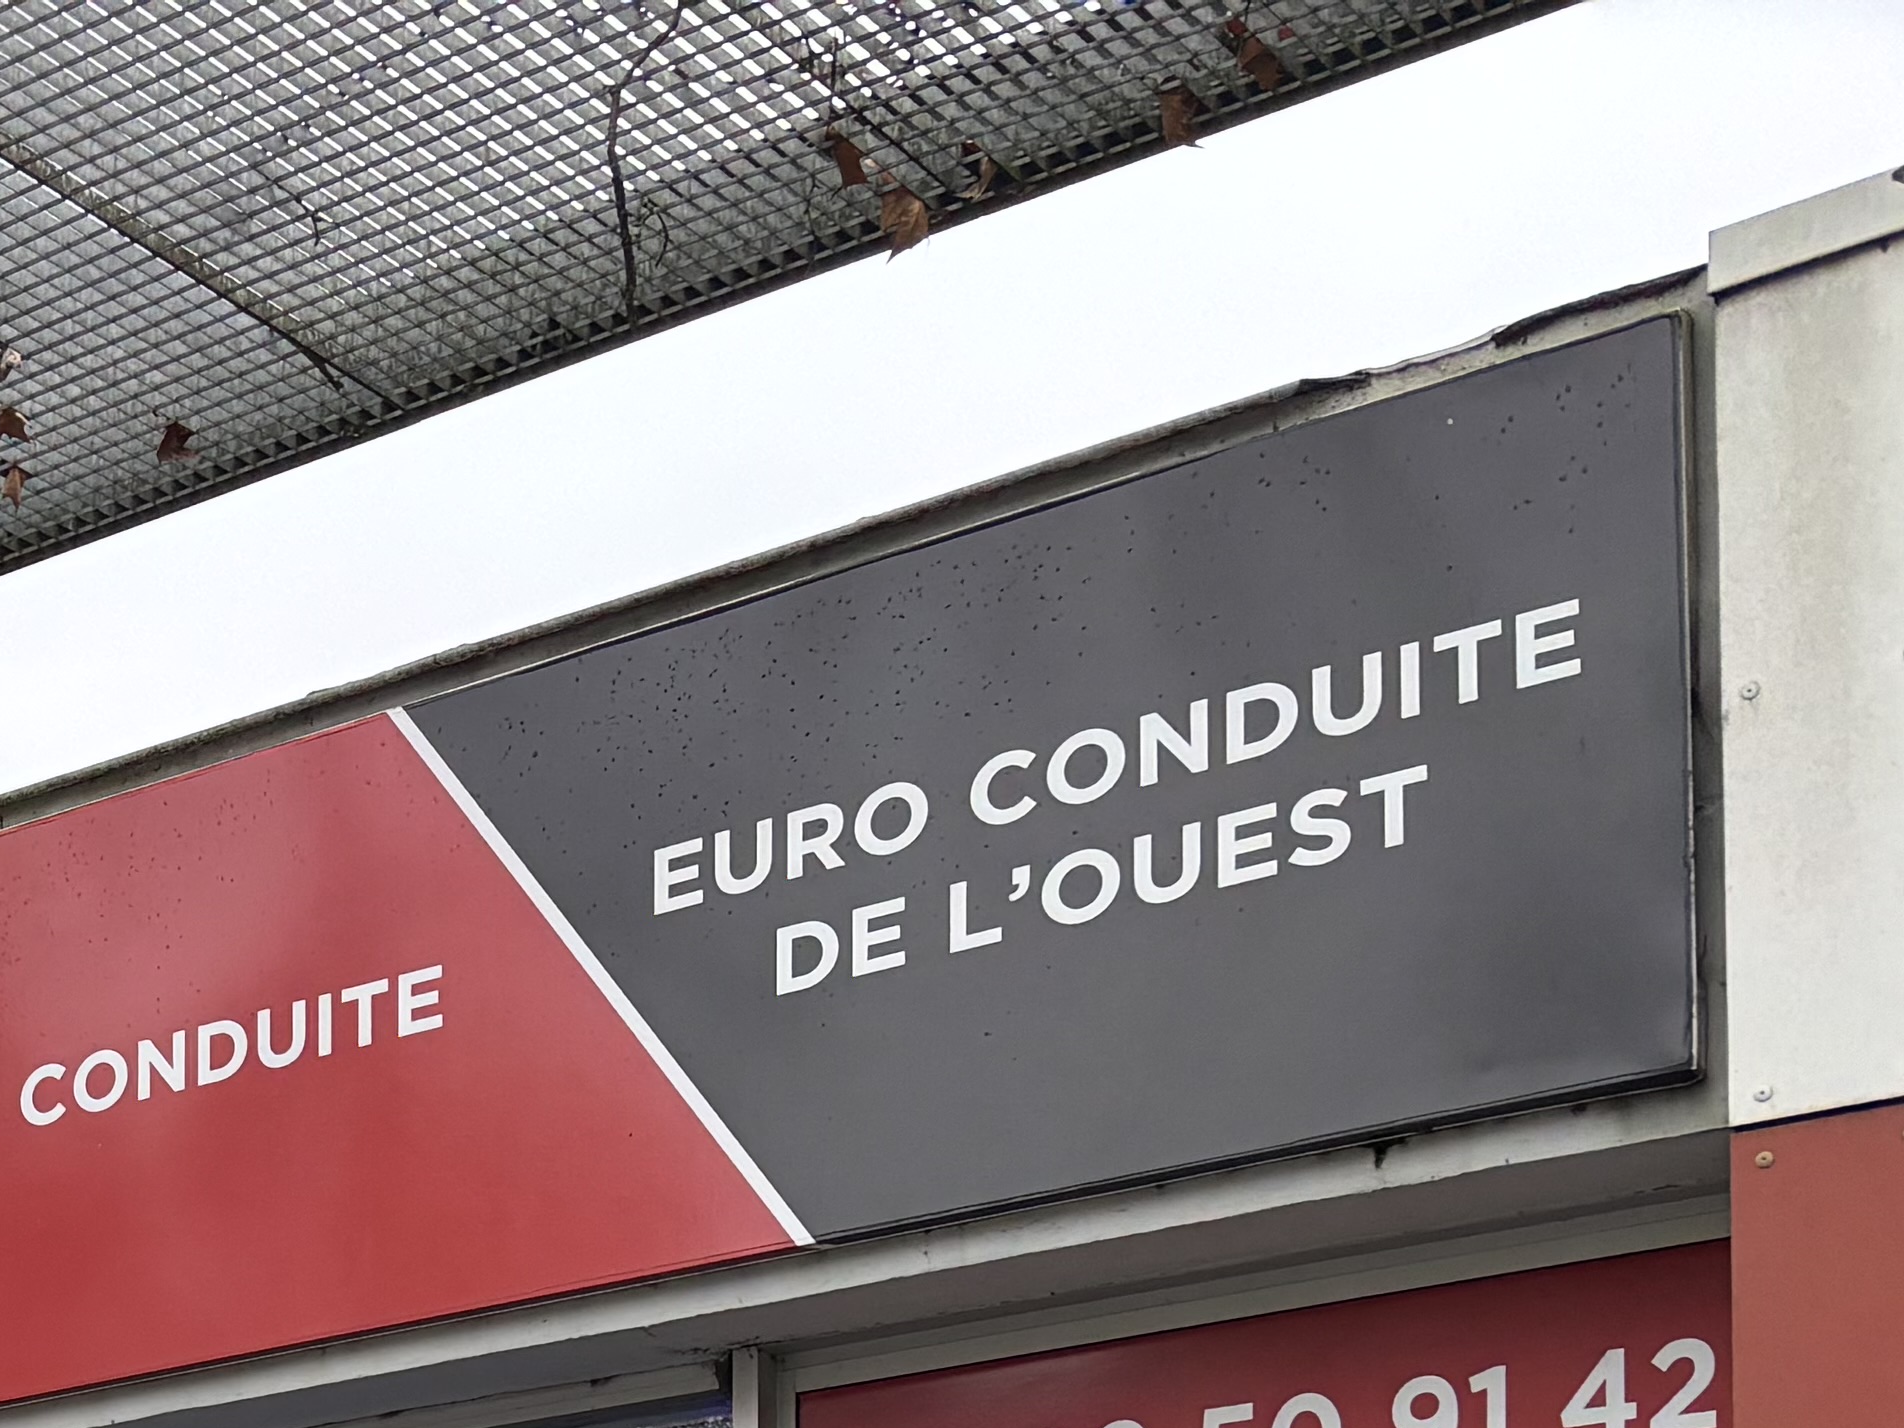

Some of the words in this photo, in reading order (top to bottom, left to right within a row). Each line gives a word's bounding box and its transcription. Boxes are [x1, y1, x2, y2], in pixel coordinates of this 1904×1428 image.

[653, 779, 929, 916] EURO
[969, 598, 1581, 826] CONDUITE
[775, 896, 906, 997] DE
[949, 764, 1428, 955] L'OUEST
[19, 964, 444, 1127] CONDUITE
